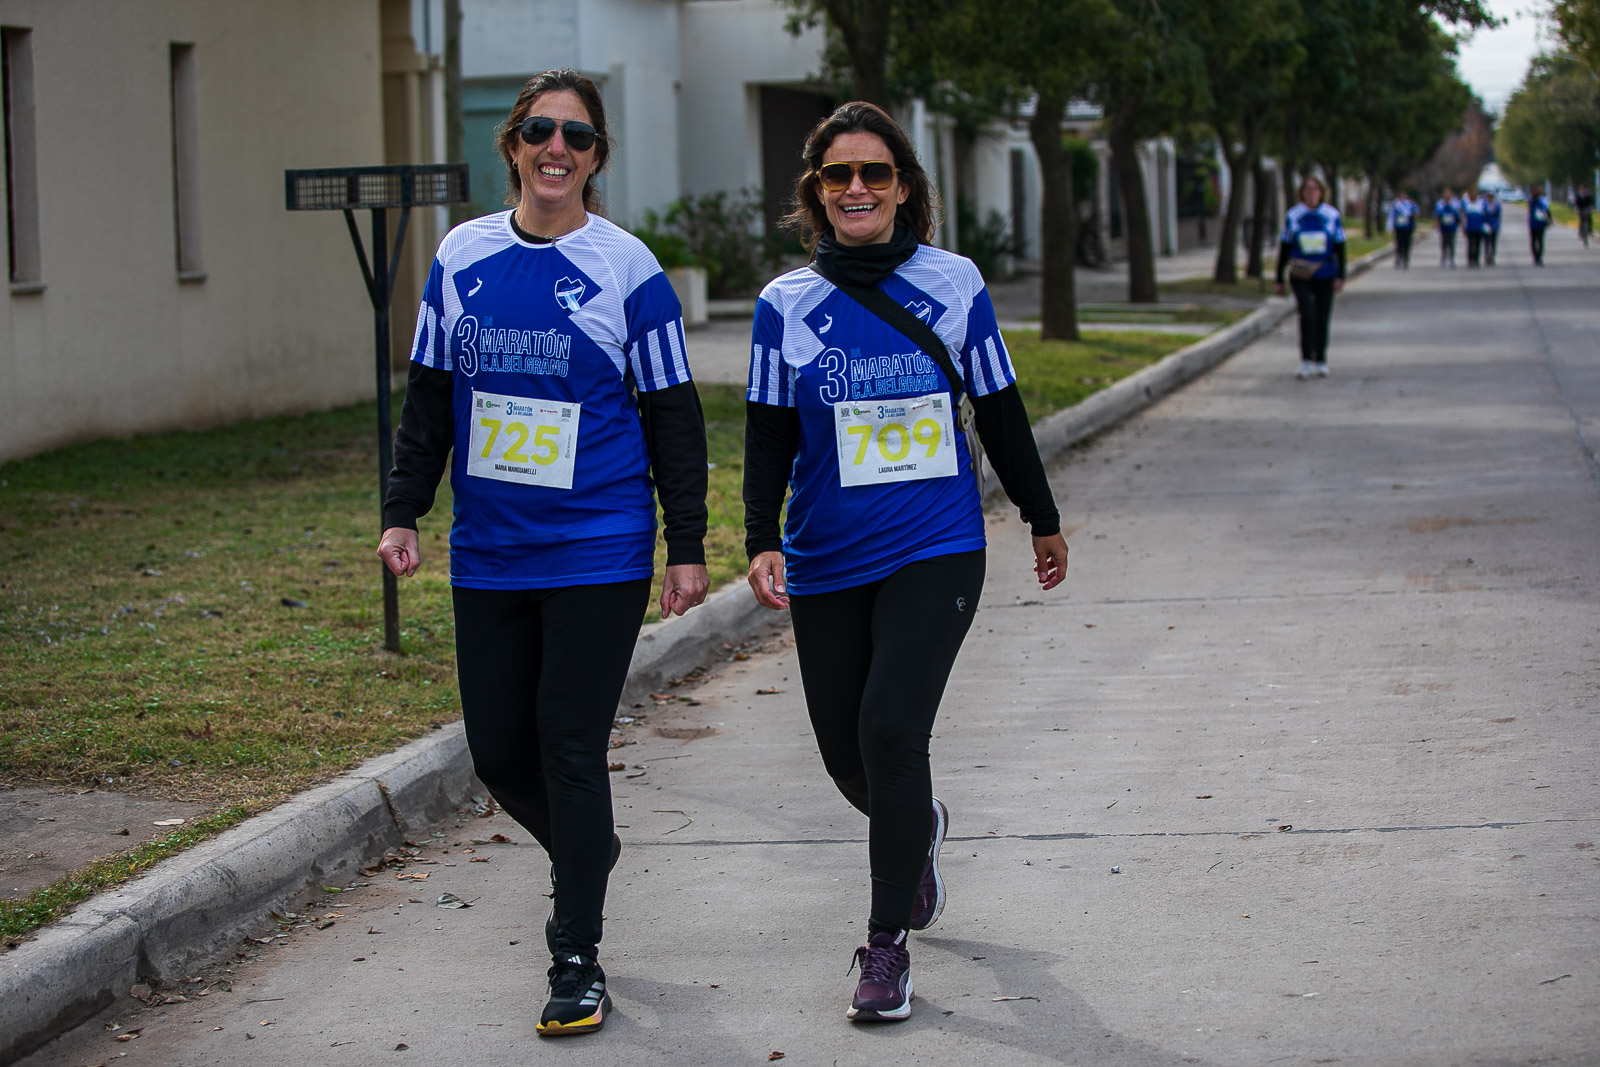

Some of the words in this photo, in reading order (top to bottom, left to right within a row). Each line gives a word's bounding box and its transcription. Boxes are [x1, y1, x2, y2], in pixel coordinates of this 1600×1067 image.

[458, 315, 478, 377] 3
[480, 328, 571, 360] MARATÓN
[818, 347, 848, 406] 3
[850, 350, 935, 382] MARATÓN
[480, 417, 560, 466] 725
[847, 418, 942, 466] 709
[495, 463, 507, 472] MARIA
[878, 466, 893, 474] LAURA
